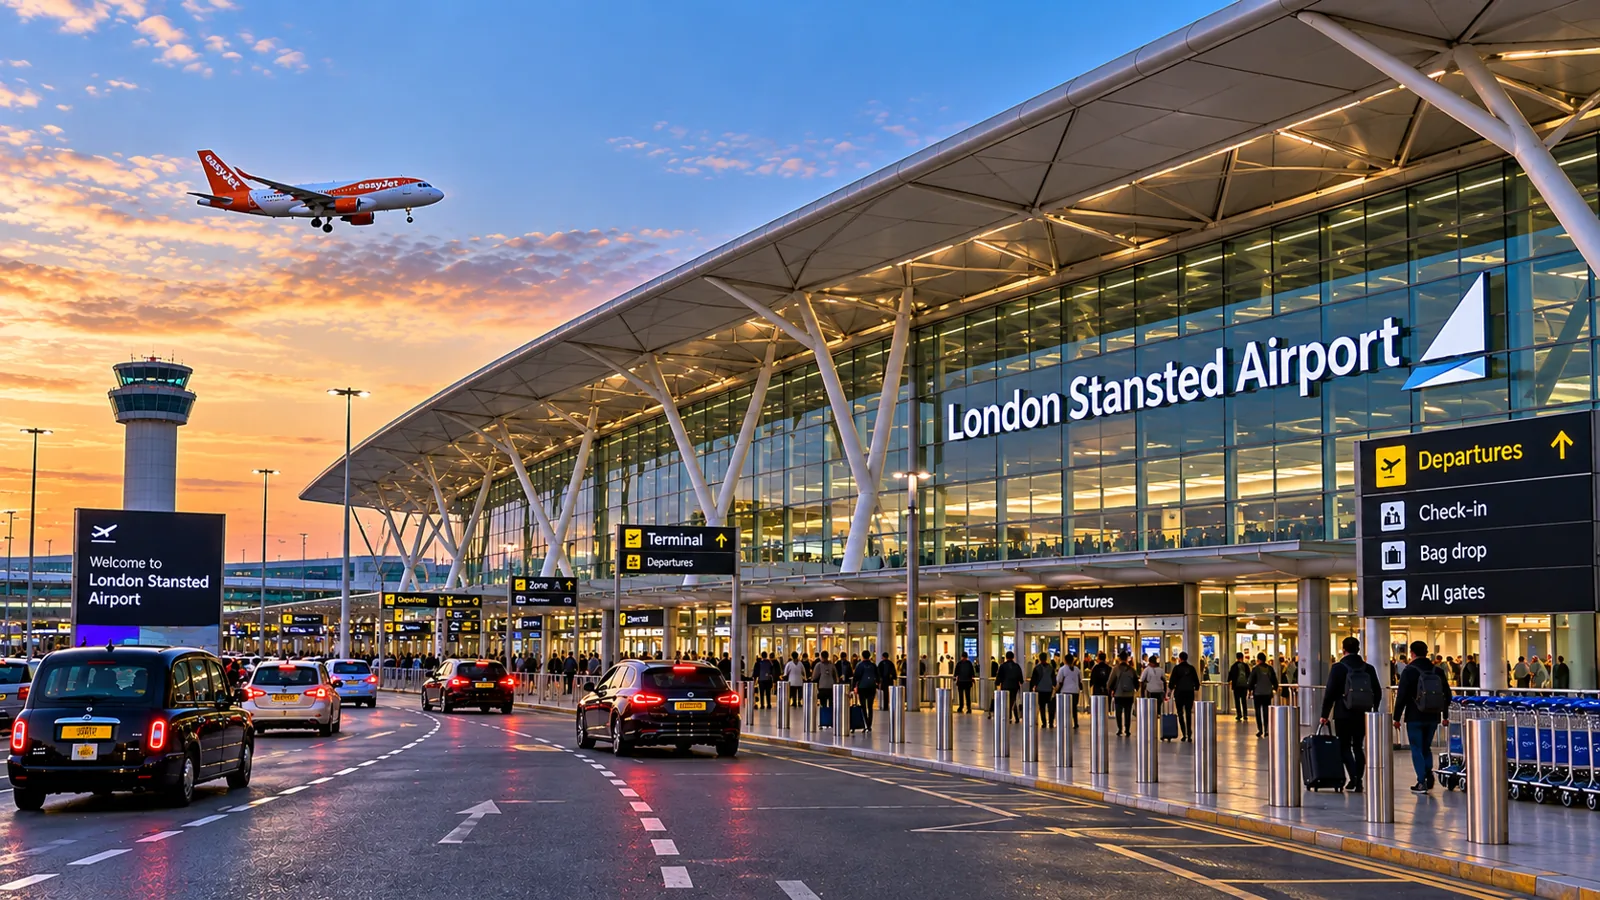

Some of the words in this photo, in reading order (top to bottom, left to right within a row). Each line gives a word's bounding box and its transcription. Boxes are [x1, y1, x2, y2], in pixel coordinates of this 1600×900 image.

[205, 154, 240, 191] easyJet
[358, 180, 398, 190] easyJet
[948, 389, 1061, 441] London
[1069, 347, 1225, 420] Stansted
[1235, 317, 1400, 398] Airport
[1418, 443, 1523, 473] Departures
[1419, 500, 1487, 521] Check-in
[647, 532, 703, 546] Terminal
[1420, 545, 1447, 563] Bag
[1452, 542, 1487, 562] drop
[89, 556, 146, 568] Welcome
[149, 558, 162, 569] to
[647, 557, 693, 569] Departures
[89, 573, 143, 587] London
[147, 574, 209, 588] Stansted
[529, 580, 548, 589] Zone
[88, 591, 141, 608] Airport
[1421, 584, 1439, 600] All
[1444, 585, 1485, 604] gates
[1050, 596, 1114, 611] Departures
